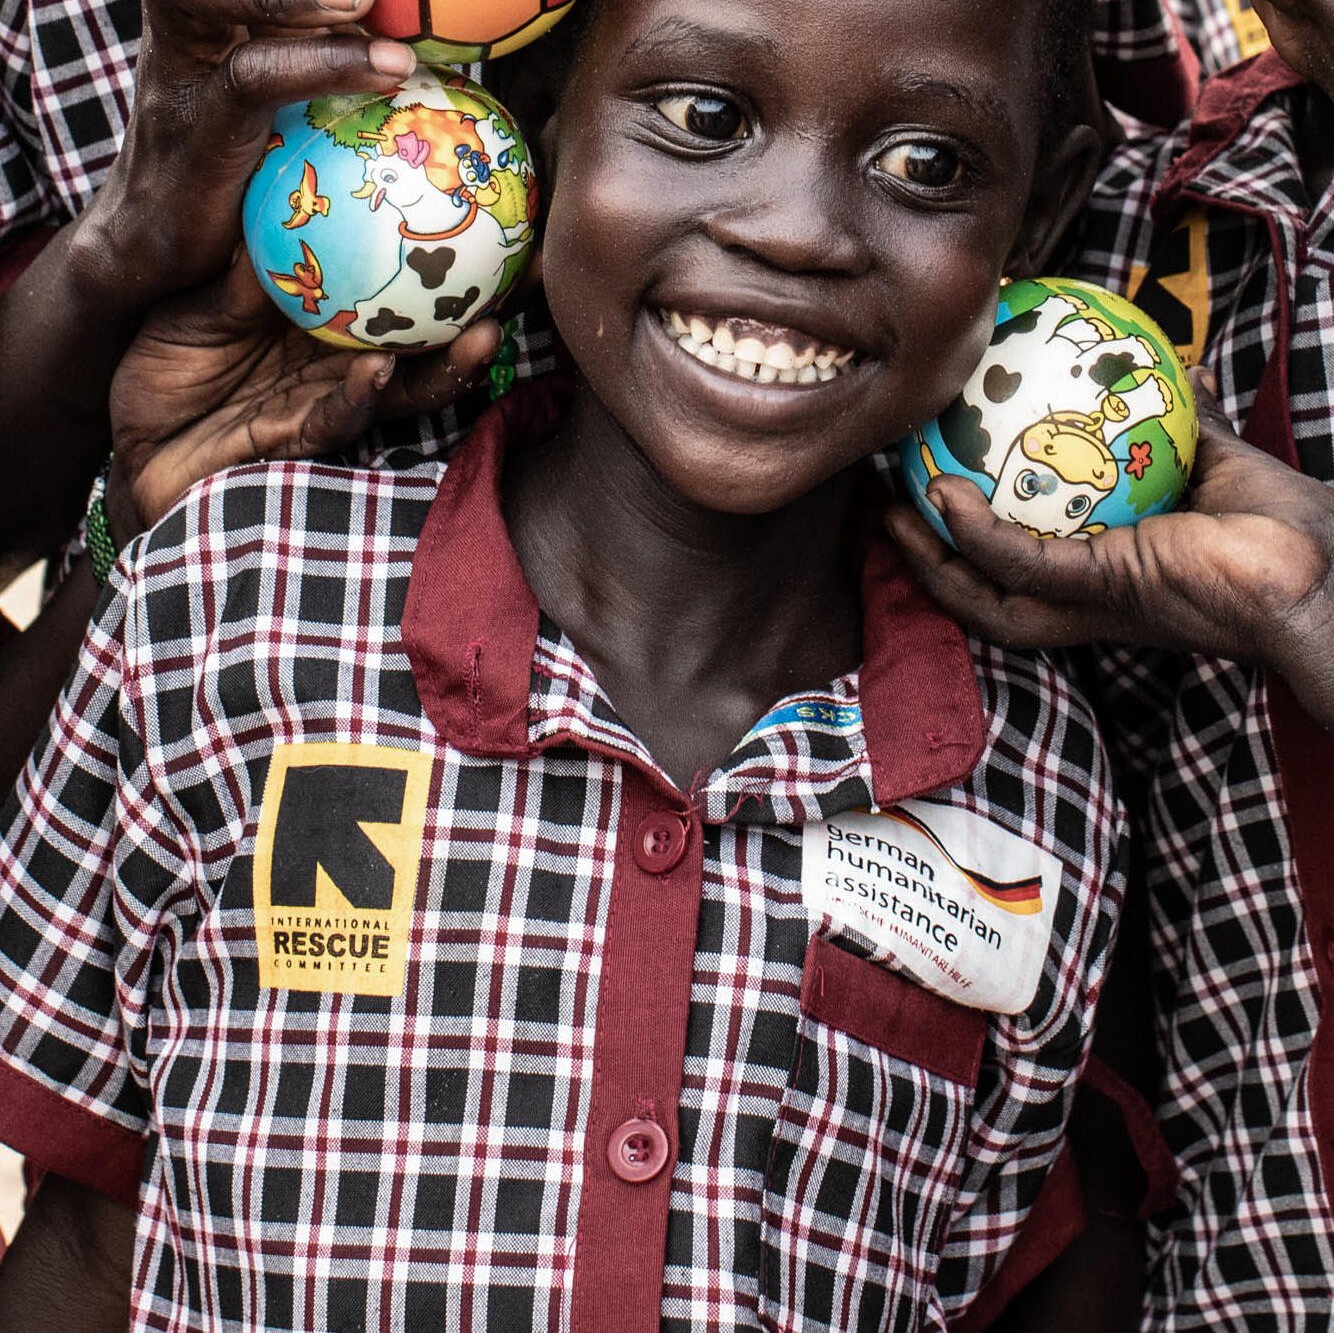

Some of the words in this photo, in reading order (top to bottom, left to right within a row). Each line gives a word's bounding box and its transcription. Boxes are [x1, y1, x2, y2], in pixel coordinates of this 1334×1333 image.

[827, 823, 936, 882] german
[825, 870, 959, 953] assistance
[827, 840, 1002, 950] humanitarian
[271, 917, 390, 931] INTERNATIONAL
[273, 931, 391, 959] RESCUE
[274, 959, 386, 973] COMMITTEE
